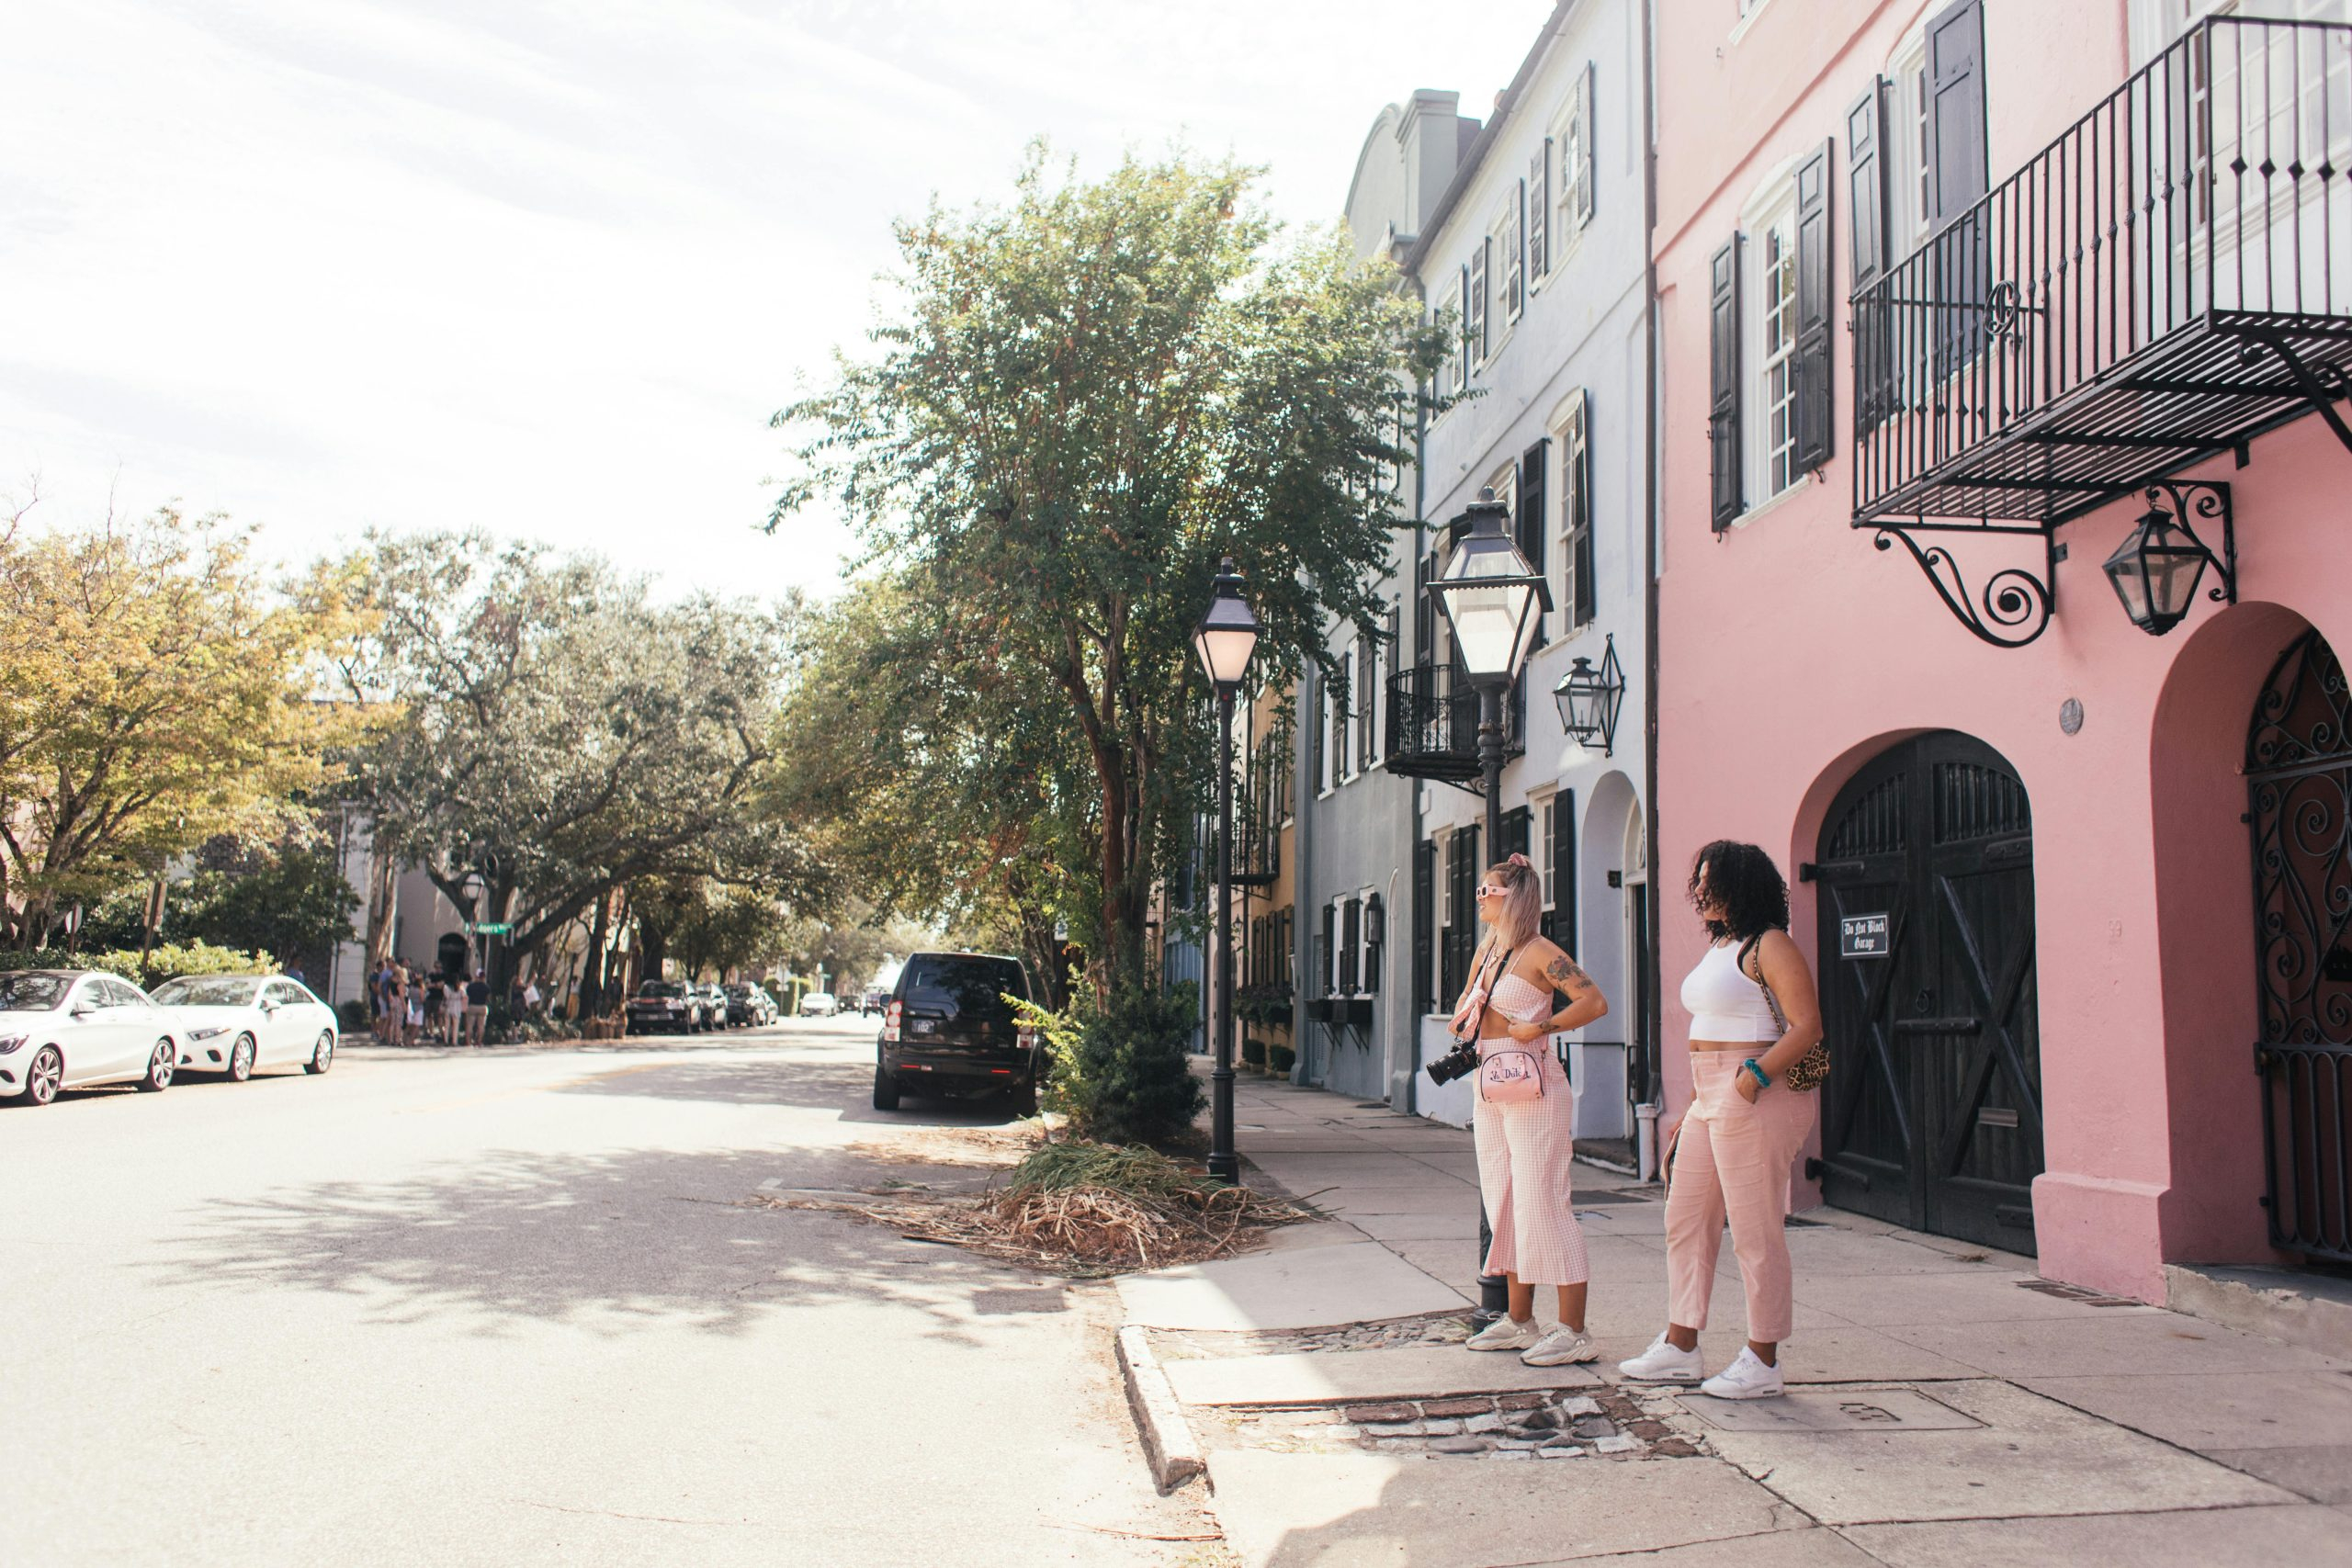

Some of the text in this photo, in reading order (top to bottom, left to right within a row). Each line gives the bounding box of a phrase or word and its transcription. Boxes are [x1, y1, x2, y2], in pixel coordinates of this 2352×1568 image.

[1844, 919, 1885, 935] Do Not Block
[1854, 937, 1875, 951] Garage
